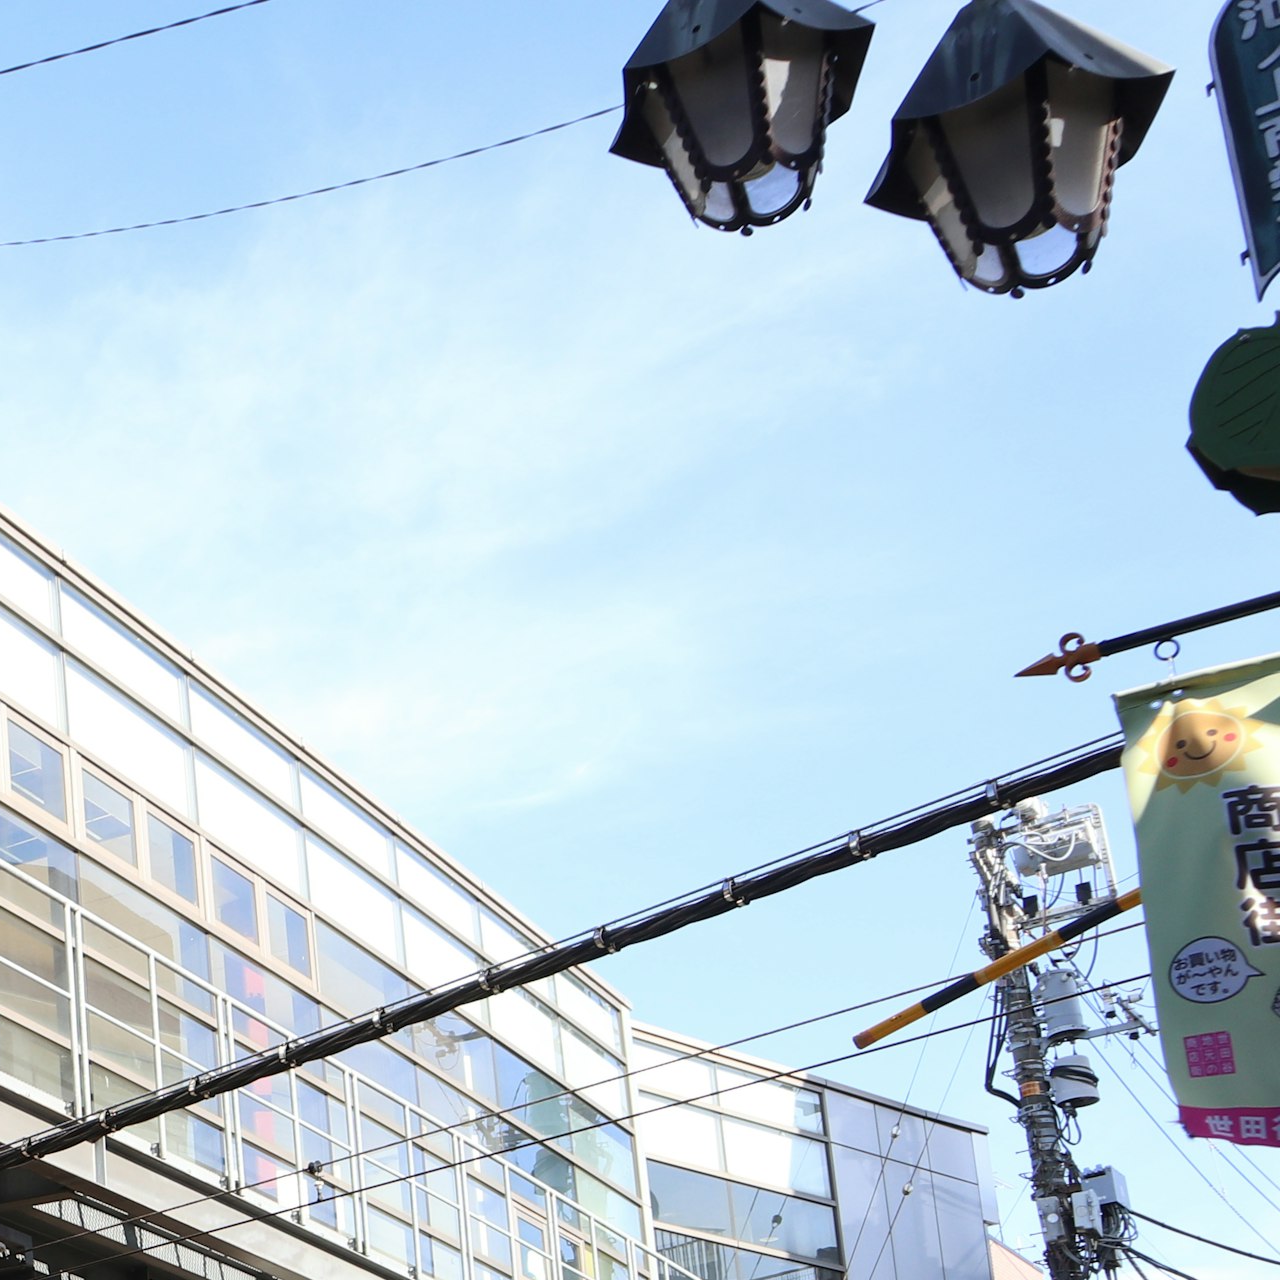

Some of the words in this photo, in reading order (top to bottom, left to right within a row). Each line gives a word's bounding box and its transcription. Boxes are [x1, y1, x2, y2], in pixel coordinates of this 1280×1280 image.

[1174, 949, 1237, 970] お買い物
[1190, 981, 1230, 996] です。
